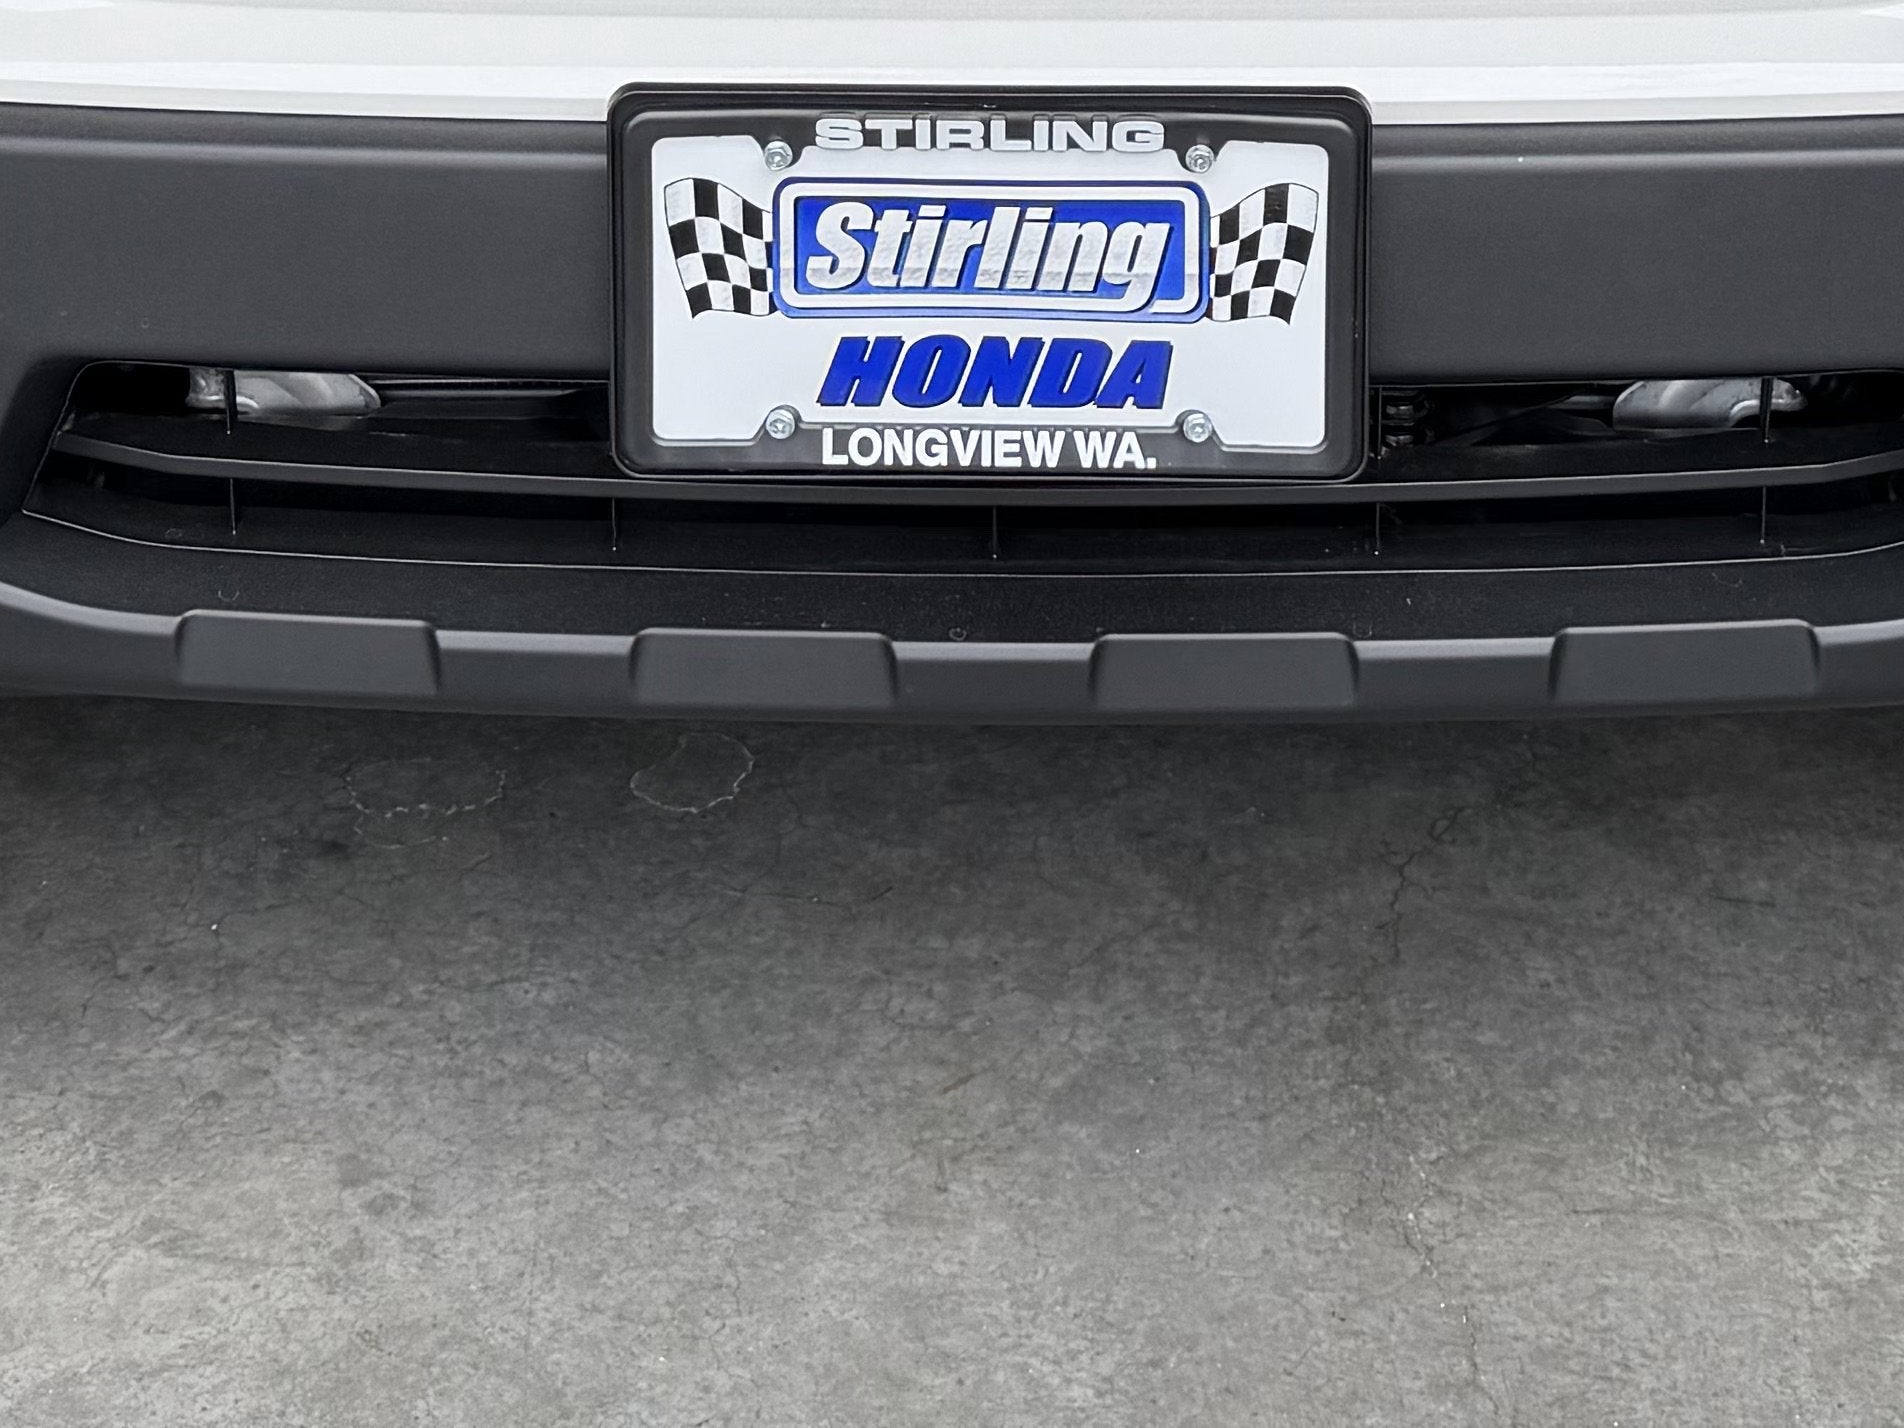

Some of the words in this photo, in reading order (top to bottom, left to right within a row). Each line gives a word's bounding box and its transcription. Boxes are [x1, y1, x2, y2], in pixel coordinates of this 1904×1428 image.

[815, 115, 1165, 152] STIRLING
[805, 200, 1173, 313] Stirling
[816, 333, 1174, 410] HONDA
[821, 427, 1065, 468] LONGVIEW
[1070, 429, 1157, 470] WA.
